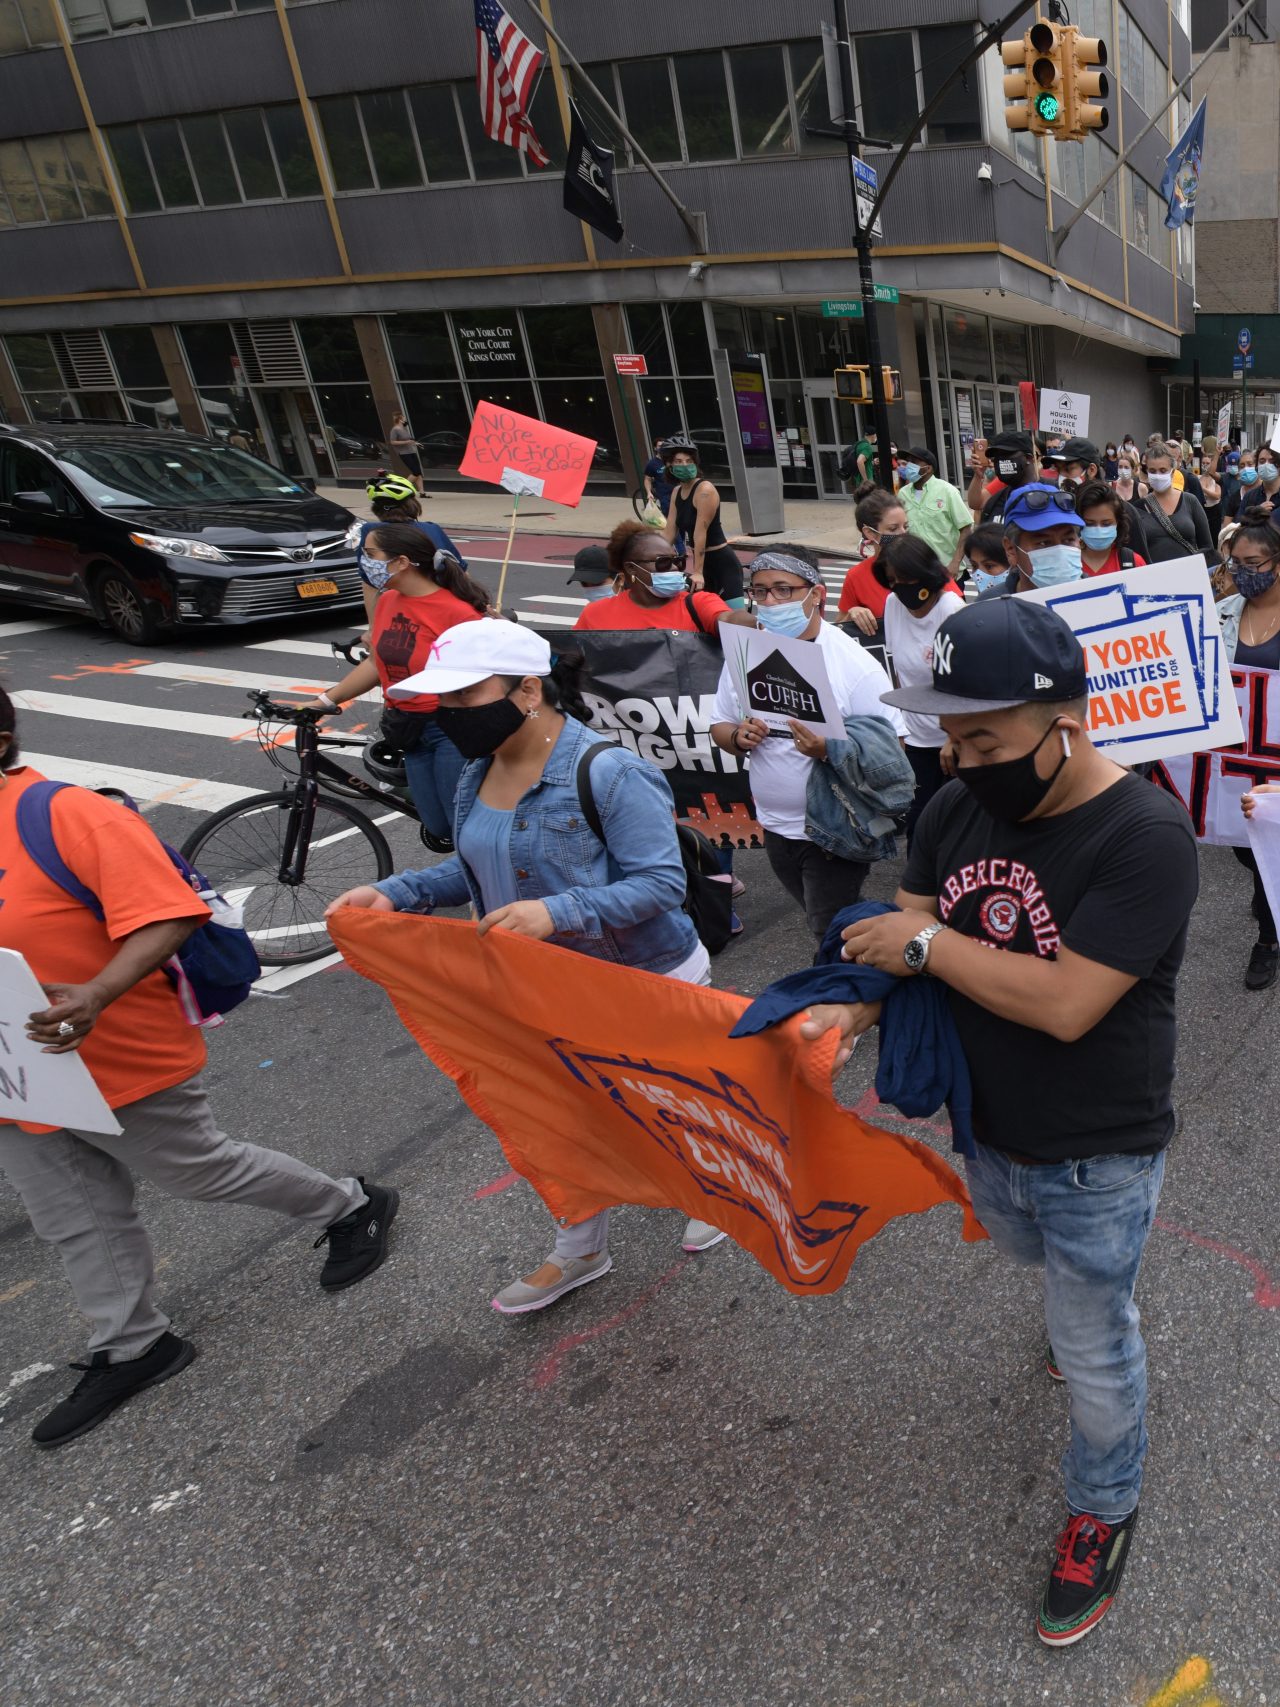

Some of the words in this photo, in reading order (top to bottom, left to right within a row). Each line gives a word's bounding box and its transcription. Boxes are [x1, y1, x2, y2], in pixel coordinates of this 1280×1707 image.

[873, 285, 891, 299] Smith
[827, 301, 857, 312] Livingston
[460, 328, 475, 338] NEW
[475, 327, 496, 338] YORK
[496, 326, 512, 337] CITY
[469, 340, 487, 349] CIVIL
[487, 339, 510, 349] COURT
[468, 352, 489, 362] KINGS
[490, 352, 516, 362] COUNTY
[480, 413, 516, 433] NO
[1049, 411, 1078, 420] HOUSING
[1051, 419, 1076, 427] JUSTICE
[472, 429, 536, 449] more
[1065, 427, 1077, 435] ALL
[525, 460, 583, 474] 2020
[1091, 630, 1173, 670] YORK
[1086, 662, 1169, 693] UNITIES
[1169, 658, 1180, 677] FOR
[752, 681, 818, 713] CUFFH
[1087, 680, 1187, 731] ANGE
[579, 692, 717, 734] ROW
[600, 728, 750, 773] IGHT
[938, 858, 1061, 956] ABERCROMBIE
